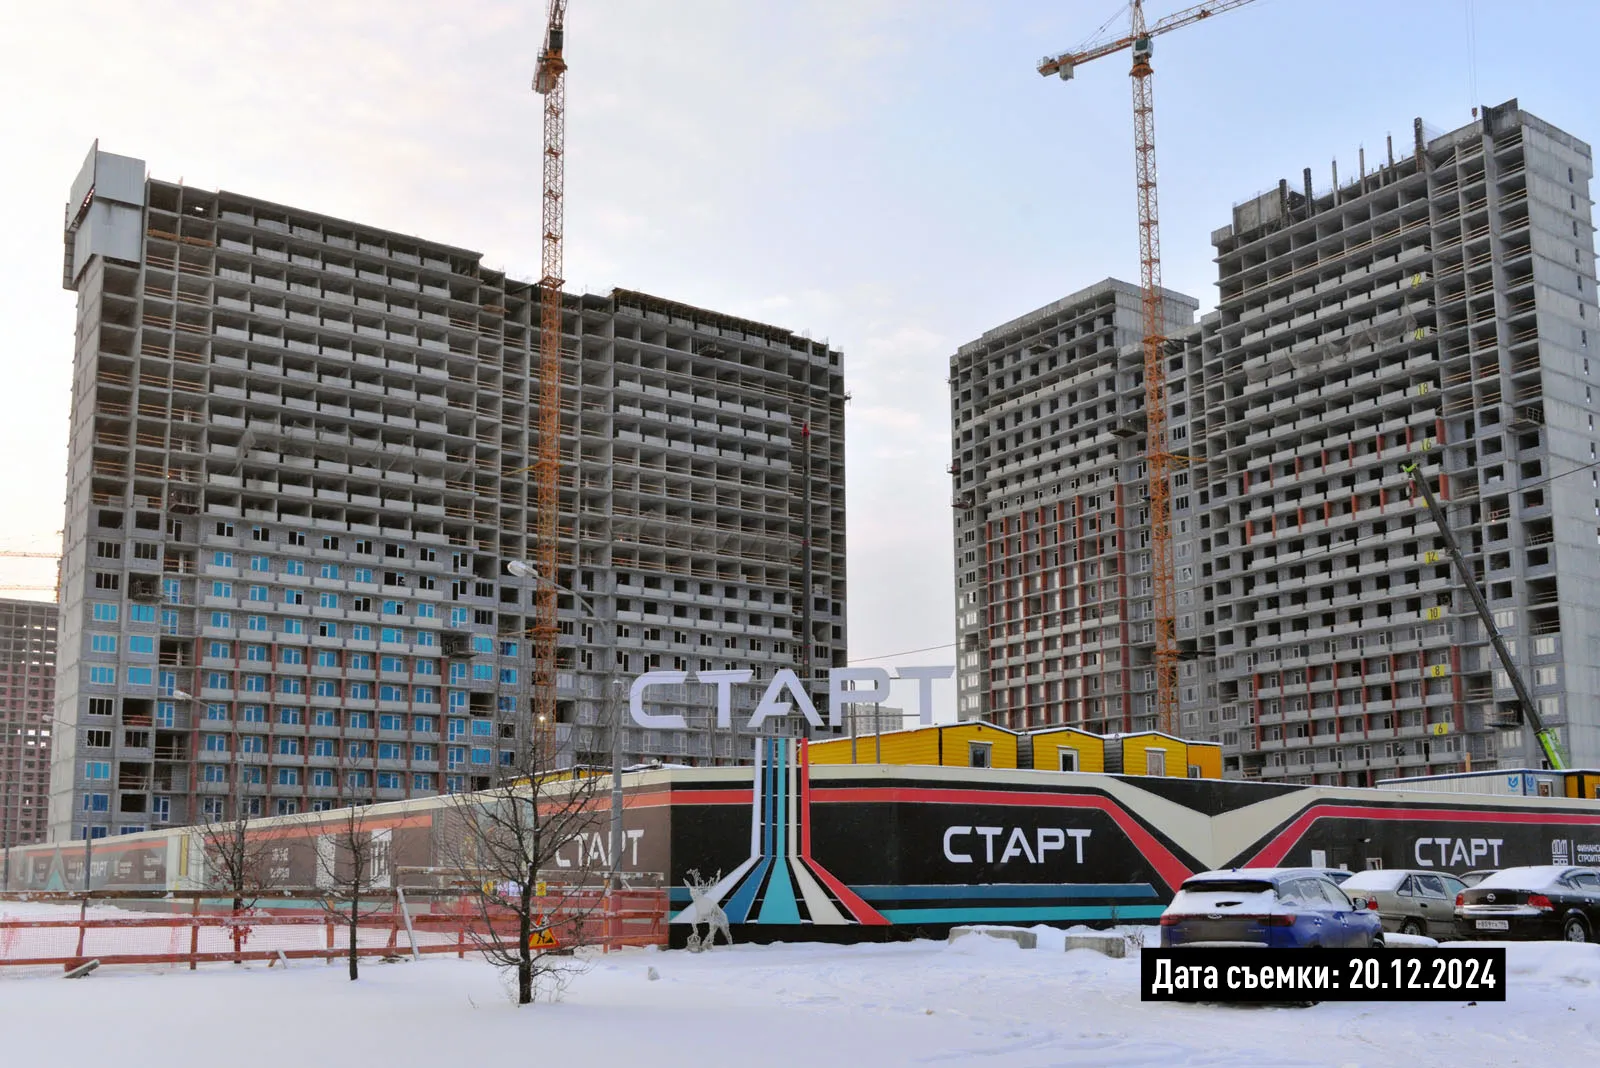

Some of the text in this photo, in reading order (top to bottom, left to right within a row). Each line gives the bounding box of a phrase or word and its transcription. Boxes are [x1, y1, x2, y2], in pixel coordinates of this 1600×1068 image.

[1427, 551, 1436, 563] 12
[1430, 607, 1438, 618] 10
[629, 665, 956, 729] СТАРТ
[943, 825, 1092, 865] СТАРТ
[1415, 837, 1503, 867] СТАРТ
